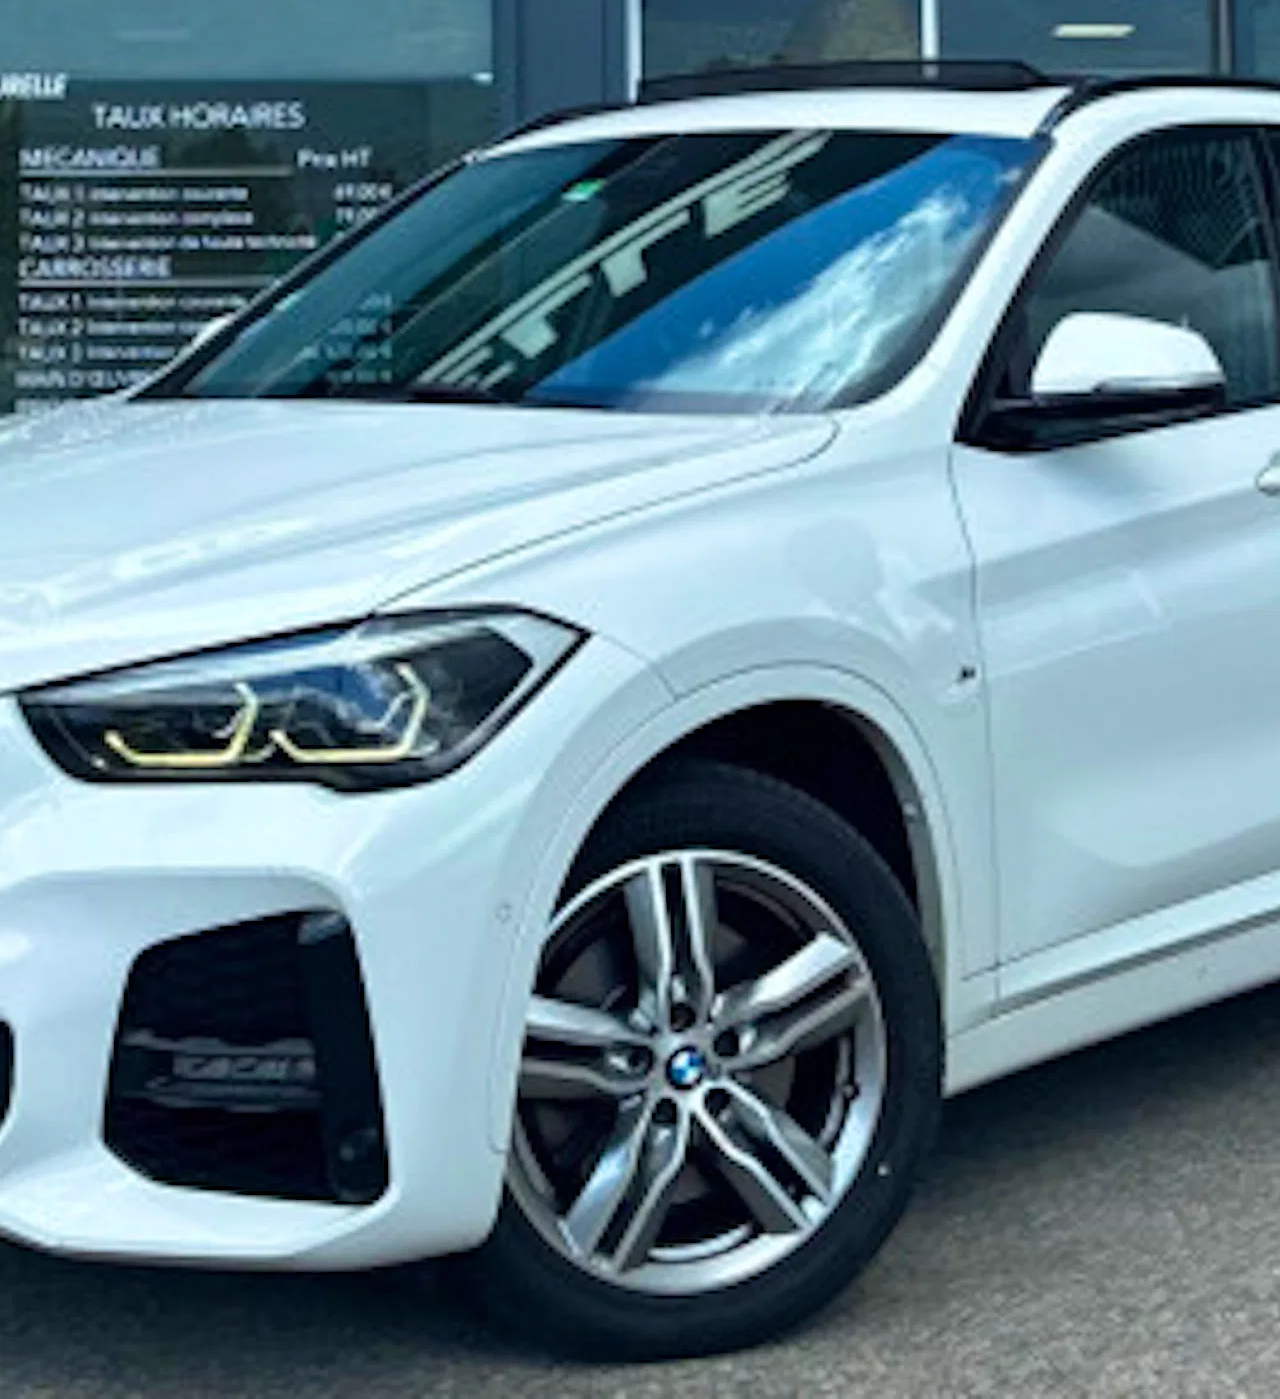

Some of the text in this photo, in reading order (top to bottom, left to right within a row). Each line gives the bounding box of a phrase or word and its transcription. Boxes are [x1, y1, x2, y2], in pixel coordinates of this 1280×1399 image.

[93, 101, 306, 130] TAUX HORAIRES
[340, 150, 373, 168] HT
[20, 182, 70, 202] TAUX
[20, 209, 70, 229] TAUX
[20, 234, 69, 253] TAUX
[19, 255, 172, 279] CARROSSERIE
[20, 292, 70, 312] TAUX
[20, 317, 70, 337] TAUX
[20, 344, 67, 364] TAUX
